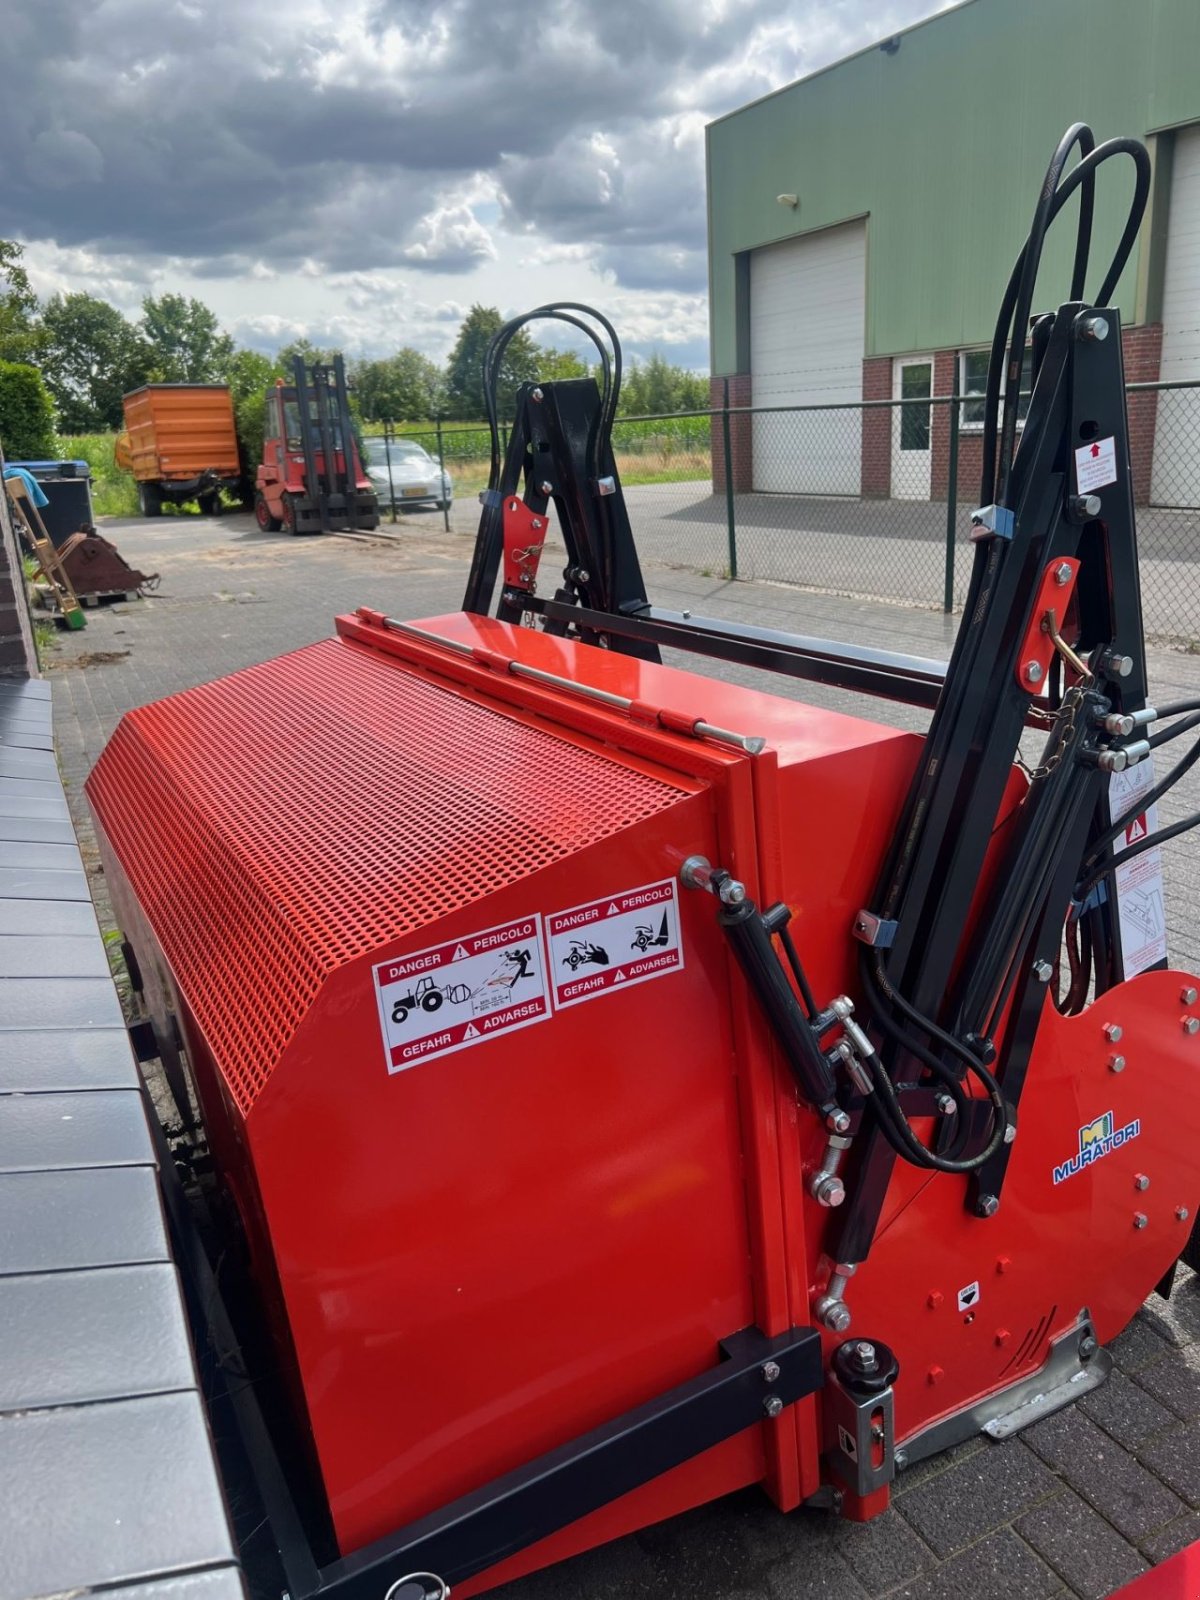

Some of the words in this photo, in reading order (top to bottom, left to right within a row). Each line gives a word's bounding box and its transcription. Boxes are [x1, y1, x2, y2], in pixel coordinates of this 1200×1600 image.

[555, 908, 599, 930] DANGER
[622, 886, 672, 908] PERICOLO
[389, 953, 441, 979] DANGER
[473, 924, 532, 951] PERICOLO
[563, 976, 605, 998] GEFAHR
[629, 953, 678, 976] ADVARSEL
[402, 1033, 452, 1059] GEFAHR
[483, 1003, 543, 1030] ADVARSEL
[1054, 1119, 1139, 1183] MURATORI
